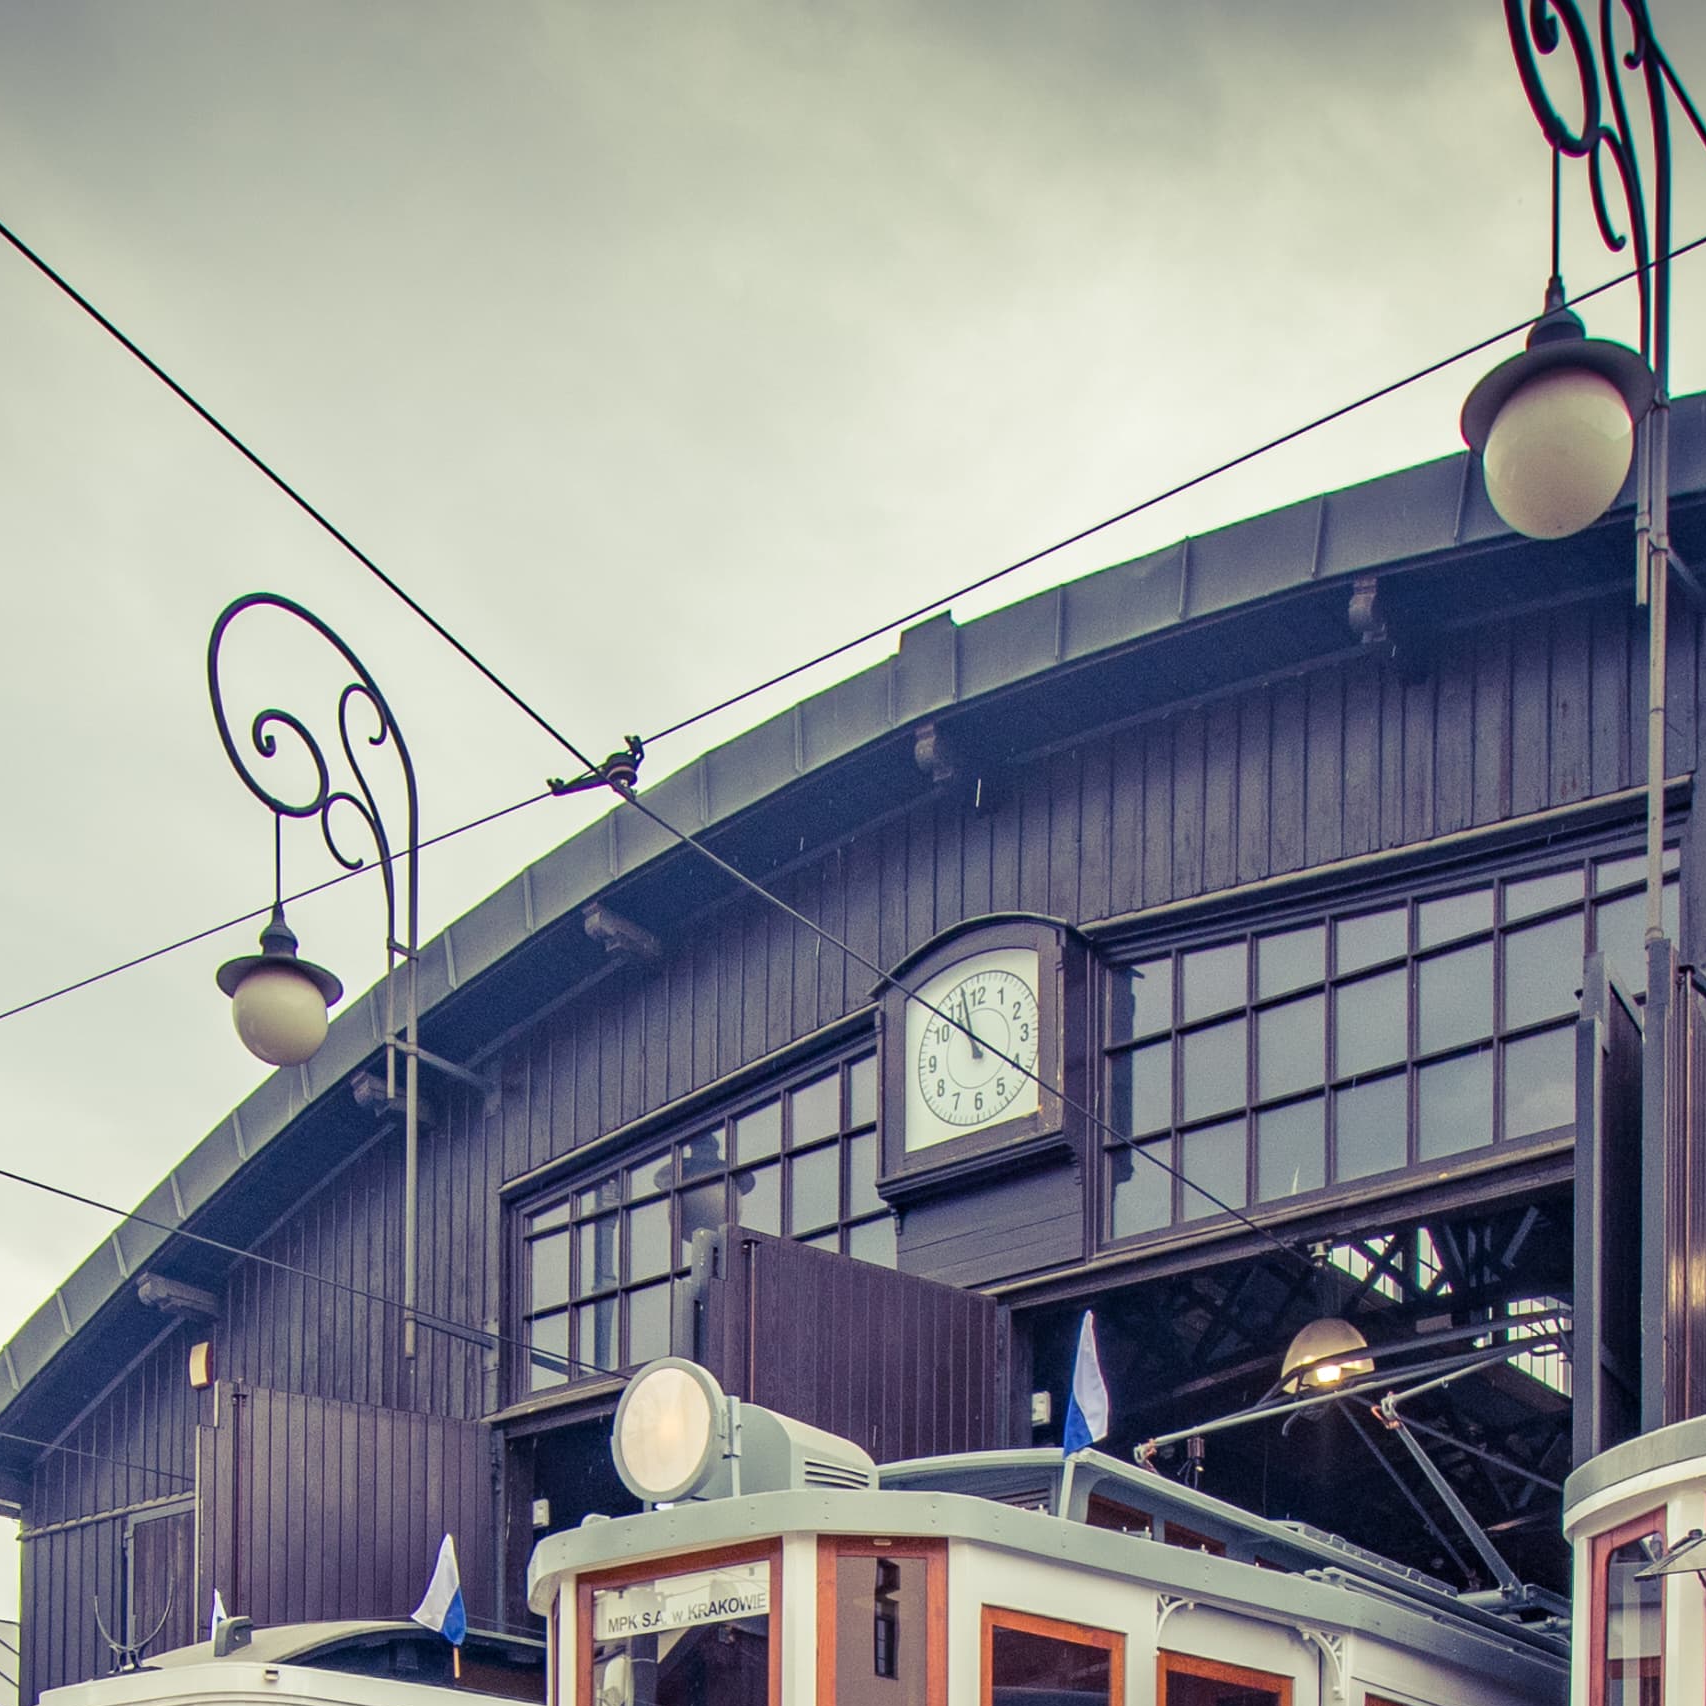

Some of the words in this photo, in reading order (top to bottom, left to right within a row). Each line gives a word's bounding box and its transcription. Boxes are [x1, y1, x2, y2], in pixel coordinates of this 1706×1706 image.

[970, 986, 986, 1007] 12
[997, 987, 1004, 1005] 1
[1012, 1002, 1021, 1020] 2
[934, 1024, 950, 1044] 10
[1020, 1023, 1029, 1041] 3
[929, 1056, 937, 1073] 9
[937, 1079, 945, 1097] 8
[996, 1077, 1005, 1096] 5
[952, 1092, 961, 1111] 7
[975, 1092, 983, 1110] 6
[608, 1614, 638, 1633] MPK
[672, 1611, 683, 1622] w
[687, 1593, 766, 1621] KRAKOWIE
